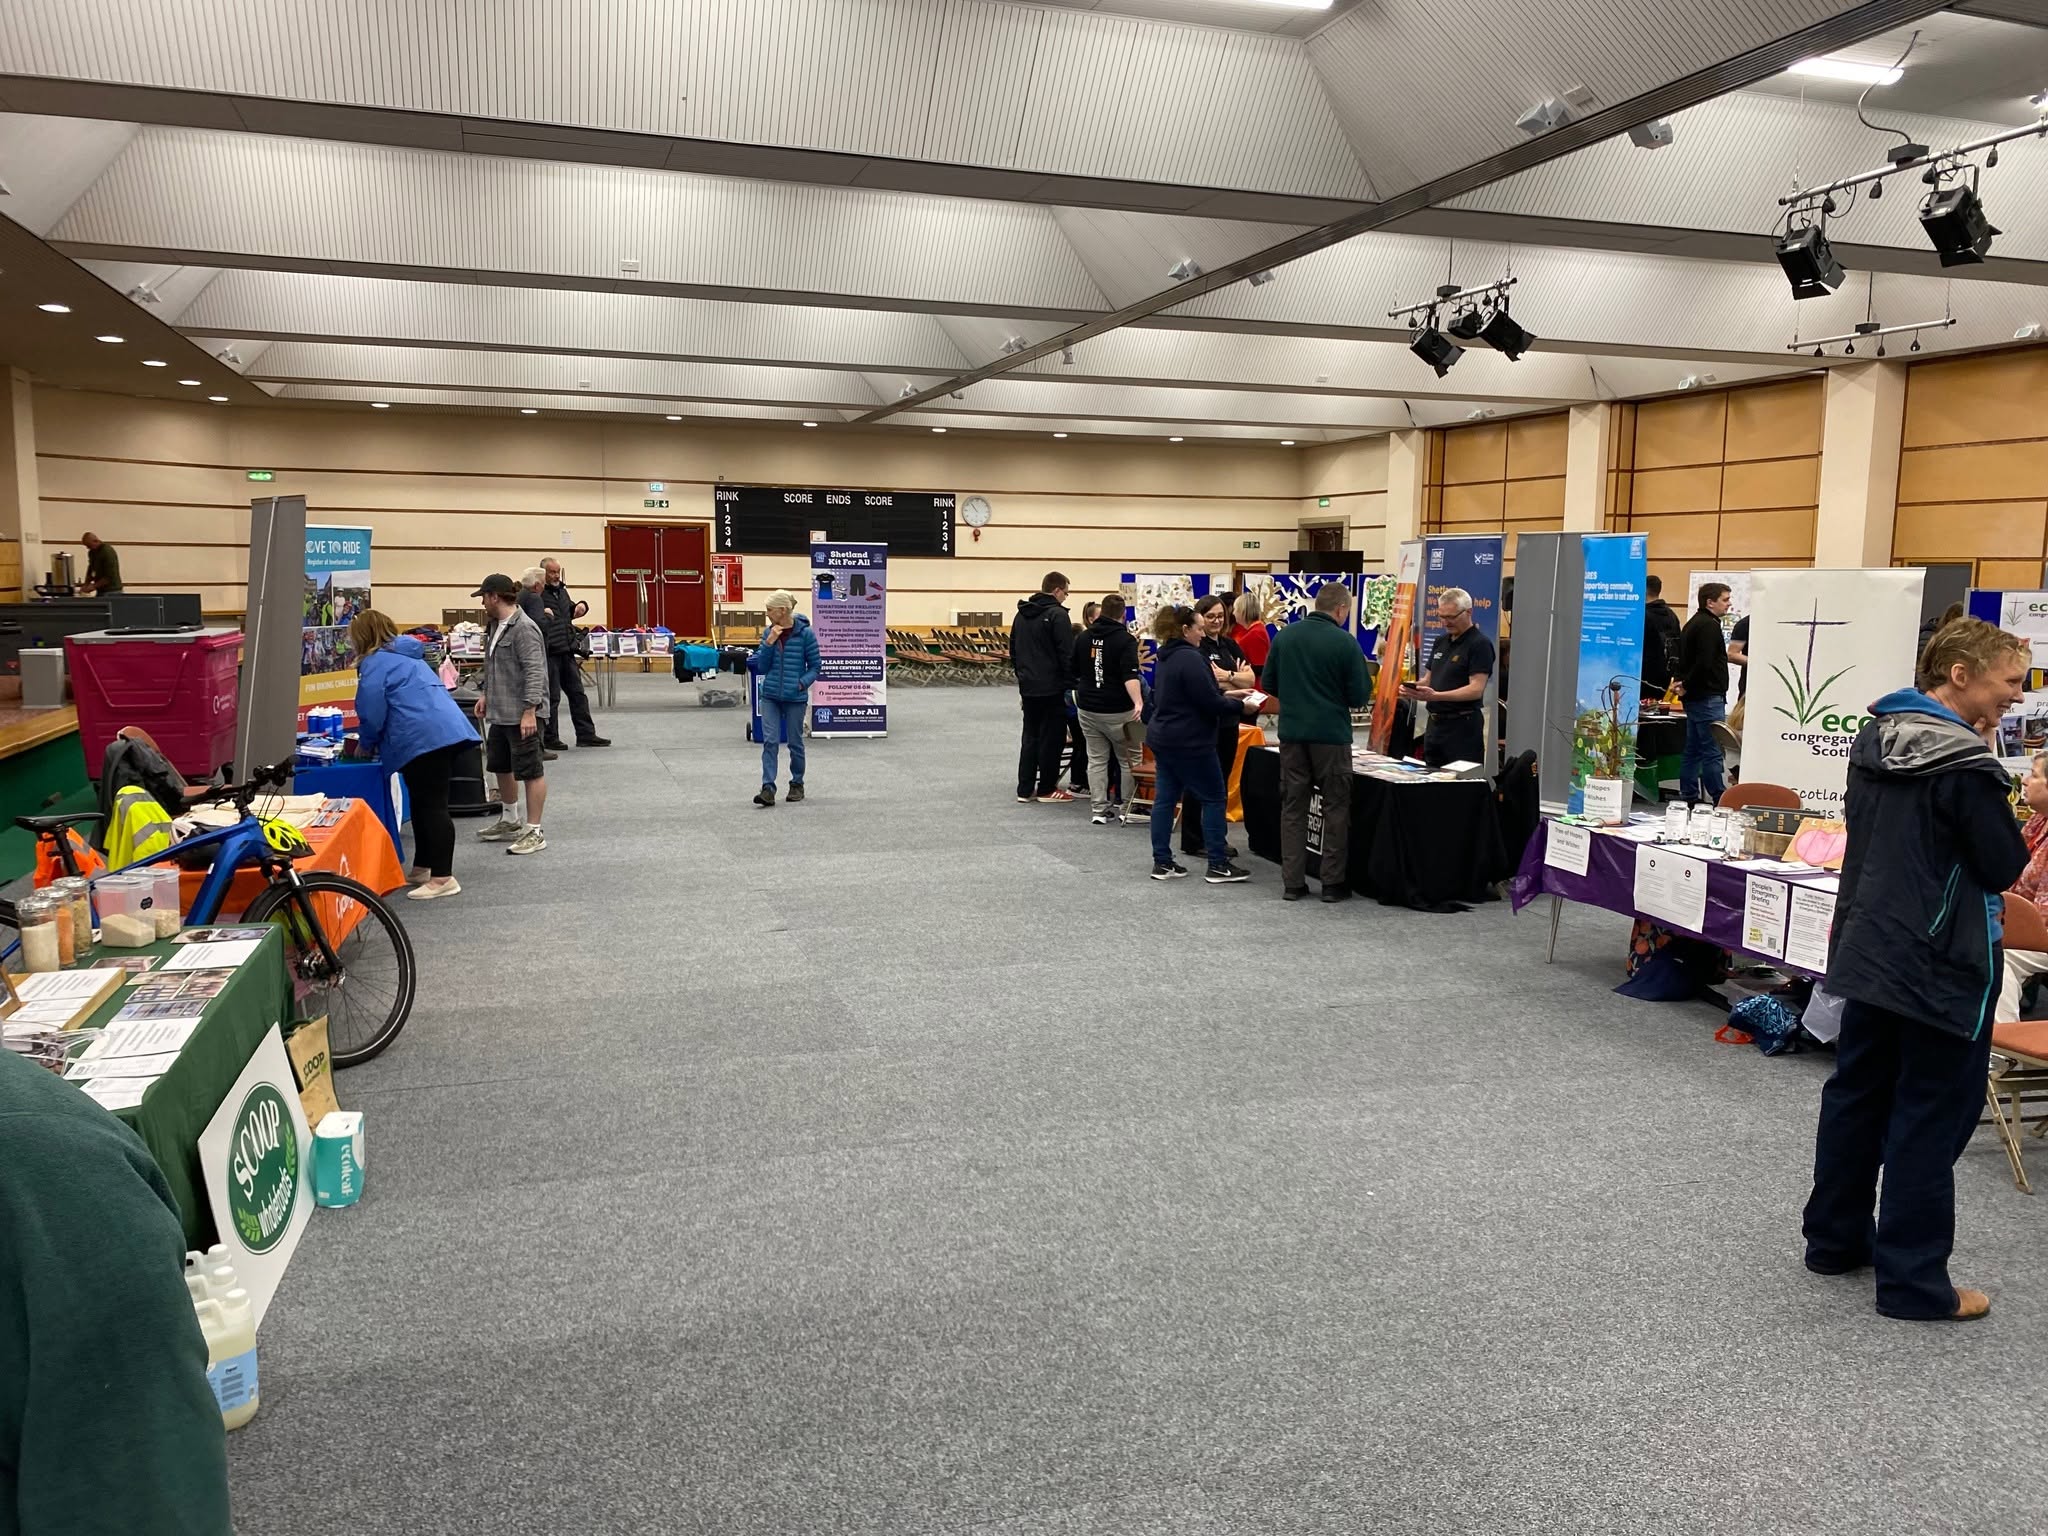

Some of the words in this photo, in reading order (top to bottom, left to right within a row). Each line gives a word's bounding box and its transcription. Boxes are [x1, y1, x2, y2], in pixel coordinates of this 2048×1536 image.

[716, 491, 739, 501] RINK
[784, 493, 813, 503] SCORE
[826, 494, 851, 504] ENDS
[864, 496, 893, 506] SCORE
[933, 498, 954, 508] RINK
[724, 503, 730, 512] 1
[724, 515, 731, 524] 2
[942, 510, 948, 519] 1
[942, 521, 948, 530] 2
[725, 526, 731, 536] 3
[942, 532, 948, 541] 3
[305, 540, 326, 553] OVE
[328, 541, 341, 553] TO
[343, 541, 360, 554] RIDE
[725, 538, 732, 547] 4
[942, 543, 948, 552] 4
[1583, 581, 1609, 593] pporting
[1583, 592, 1597, 602] ergy
[1473, 597, 1491, 609] help
[2028, 603, 2048, 612] ec
[334, 678, 358, 688] CHALLEN
[297, 712, 305, 721] ET
[1781, 732, 1857, 747] congregat
[1811, 745, 1849, 758] Scotl
[1790, 788, 1846, 801] cotla
[1570, 831, 1583, 839] Hopes
[1752, 882, 1773, 892] People's
[1752, 888, 1779, 901] Emergency
[1752, 894, 1770, 905] Briefing
[233, 1099, 280, 1202] SCOOP
[341, 1143, 354, 1197] ecoleaf
[257, 1166, 294, 1238] wholefoods
